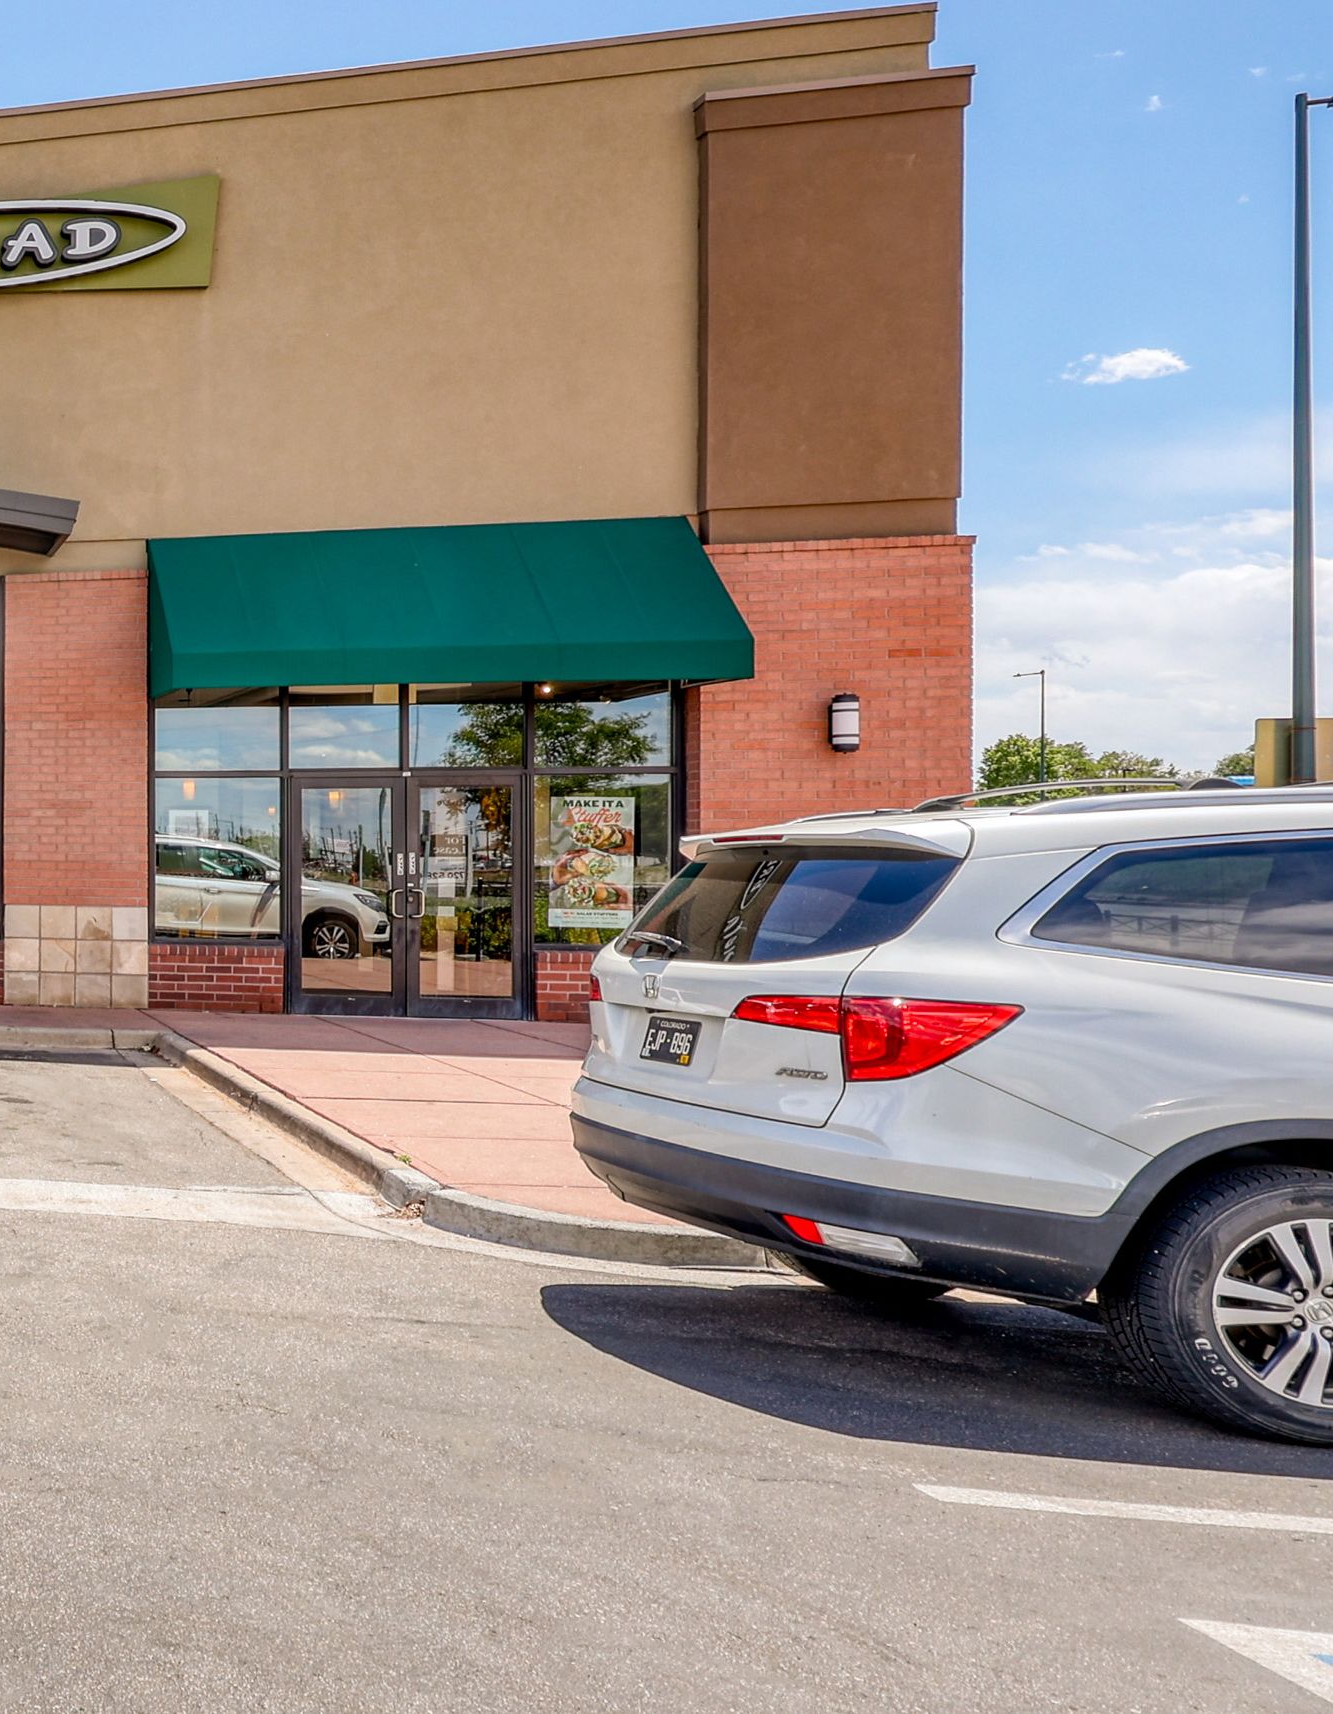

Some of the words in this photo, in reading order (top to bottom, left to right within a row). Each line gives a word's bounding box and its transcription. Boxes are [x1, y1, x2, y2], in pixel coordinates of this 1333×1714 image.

[563, 800, 599, 808] MAKE
[602, 800, 614, 808] IT
[615, 800, 624, 808] A
[564, 807, 622, 825] Stuffer
